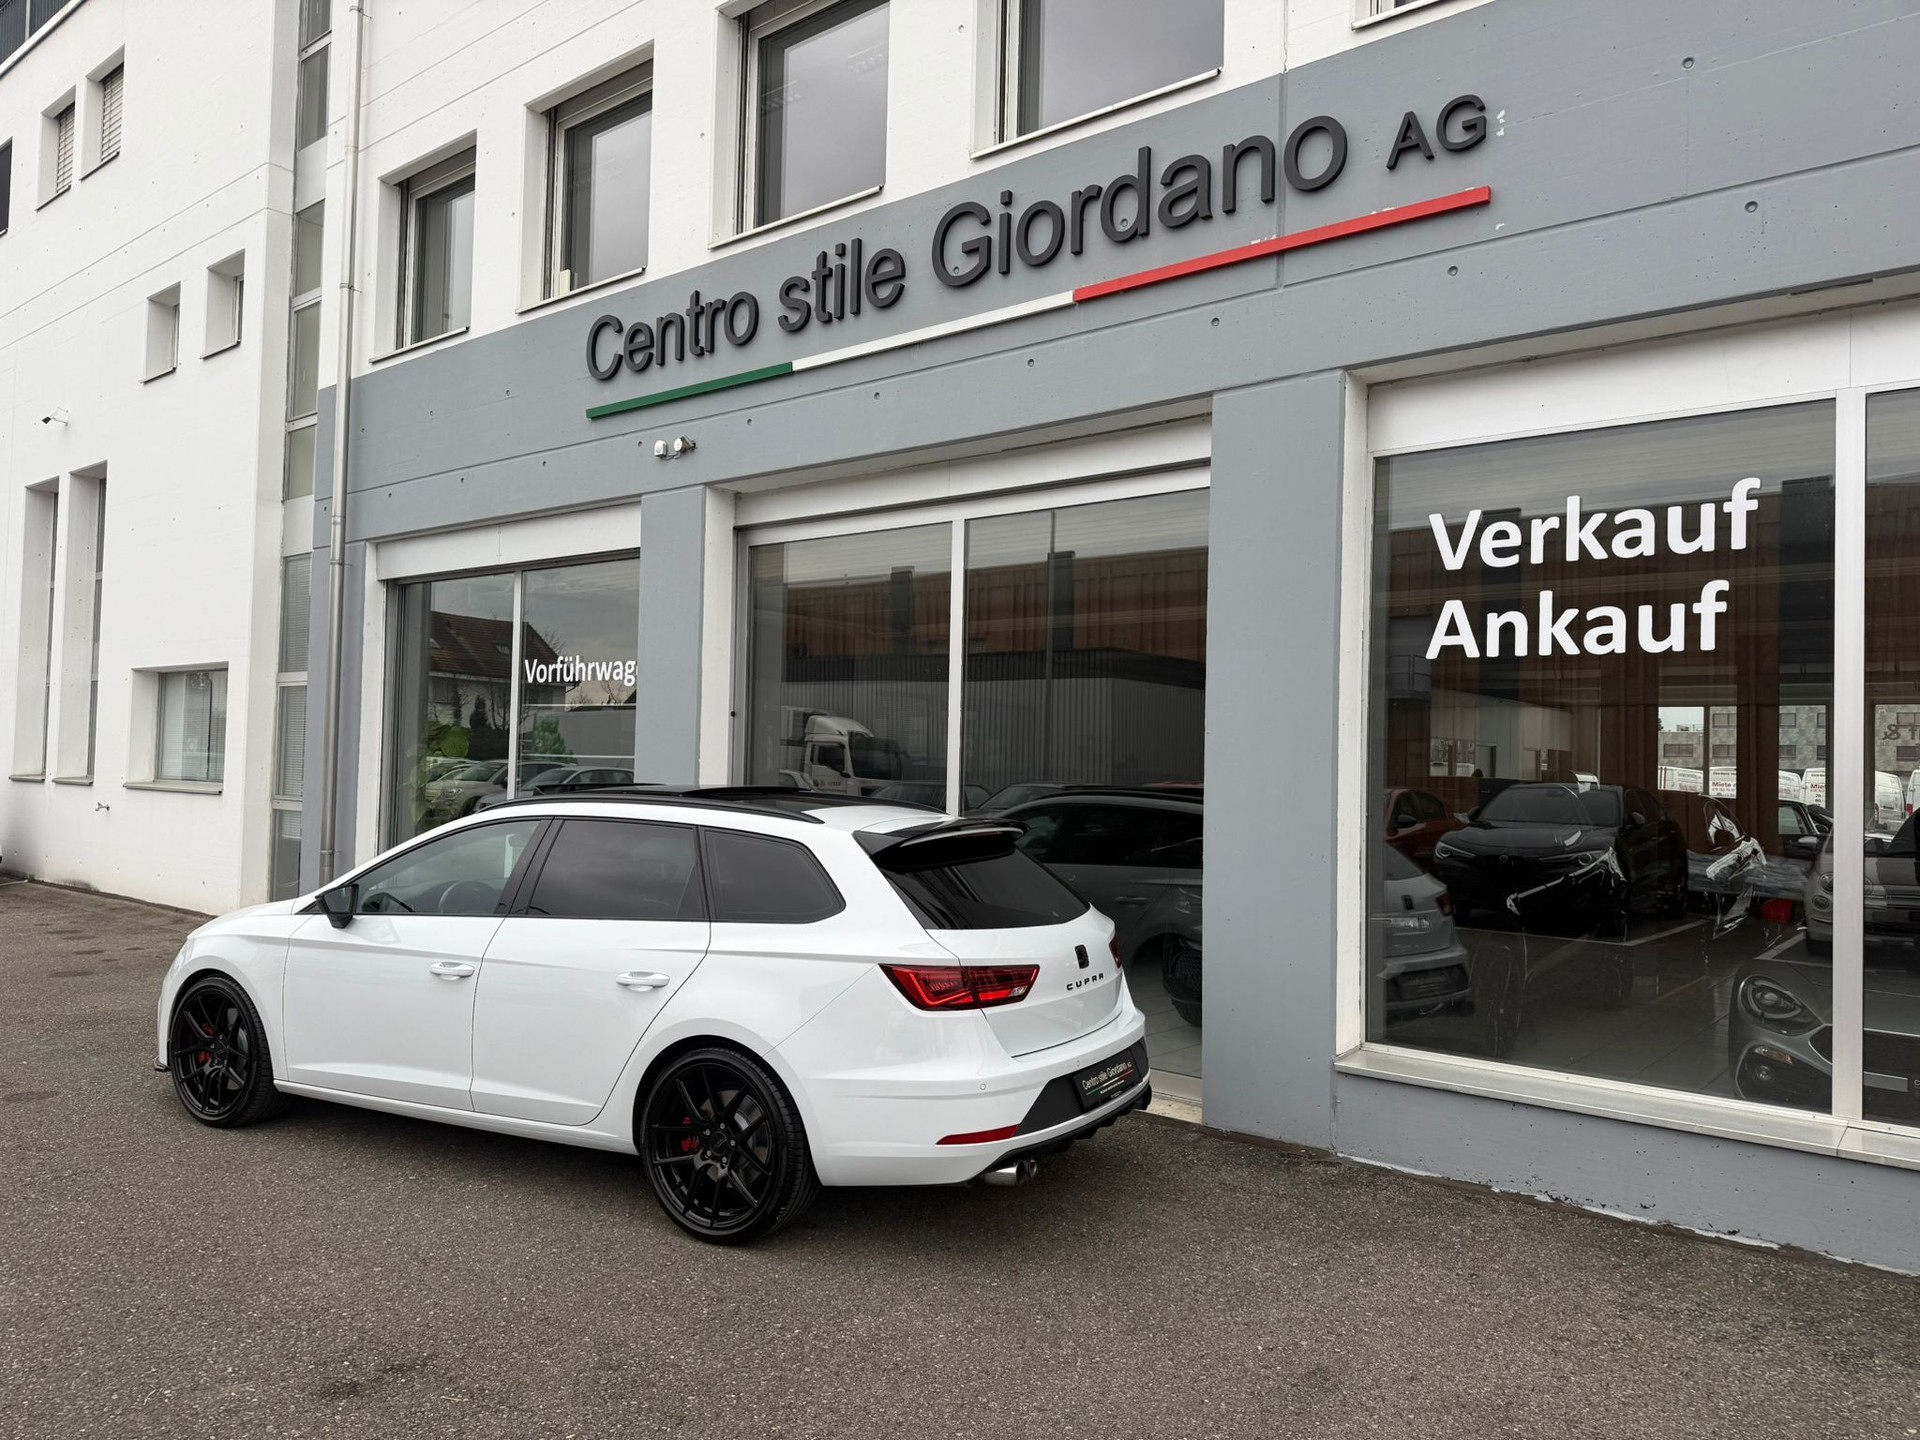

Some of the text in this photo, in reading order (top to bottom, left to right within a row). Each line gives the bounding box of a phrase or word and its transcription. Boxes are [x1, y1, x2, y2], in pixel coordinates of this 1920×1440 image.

[586, 94, 1489, 381] Centro stile Giordano AG
[1428, 477, 1761, 571] Verkauf
[1425, 579, 1730, 660] Ankauf
[524, 655, 638, 687] Vorführwag
[1066, 972, 1104, 991] CUPRA
